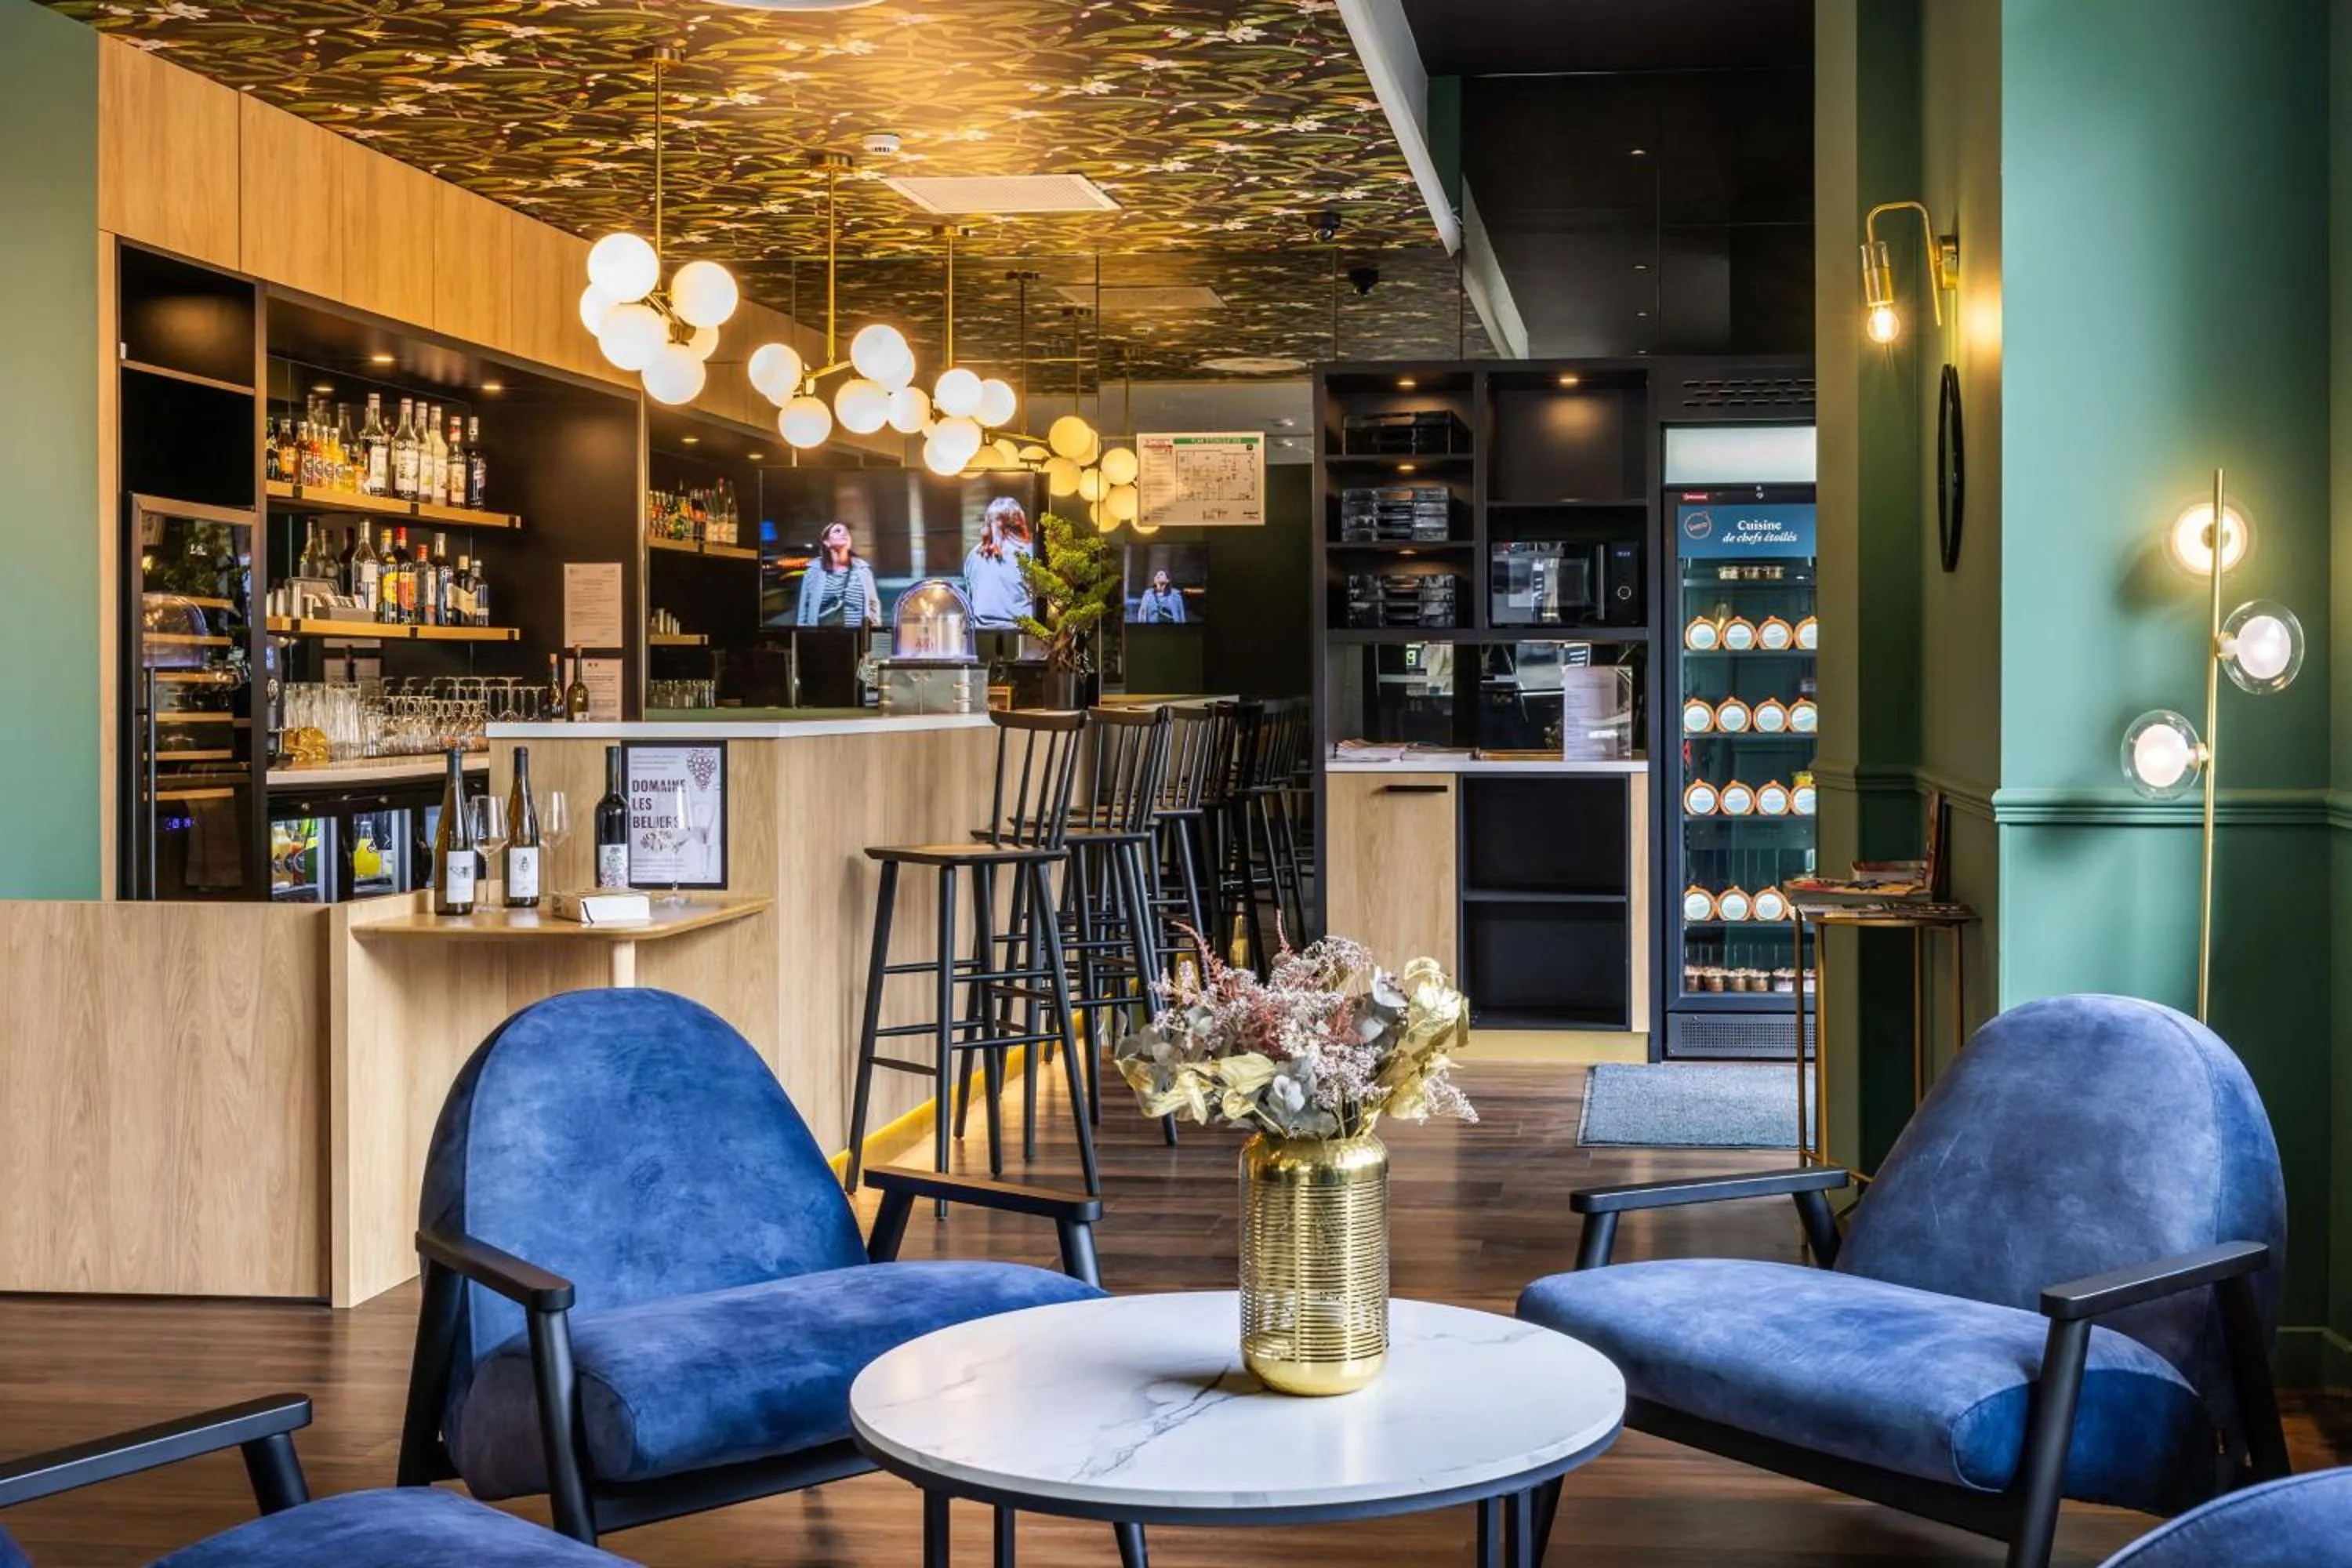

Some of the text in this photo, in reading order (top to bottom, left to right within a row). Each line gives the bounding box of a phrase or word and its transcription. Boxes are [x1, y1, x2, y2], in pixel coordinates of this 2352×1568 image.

[1737, 520, 1782, 531] Cuisine
[1722, 532, 1736, 543] de
[1736, 532, 1763, 545] chefs
[632, 779, 686, 793] DOMAINE
[632, 797, 652, 811] LES
[633, 816, 679, 829] BELIERS
